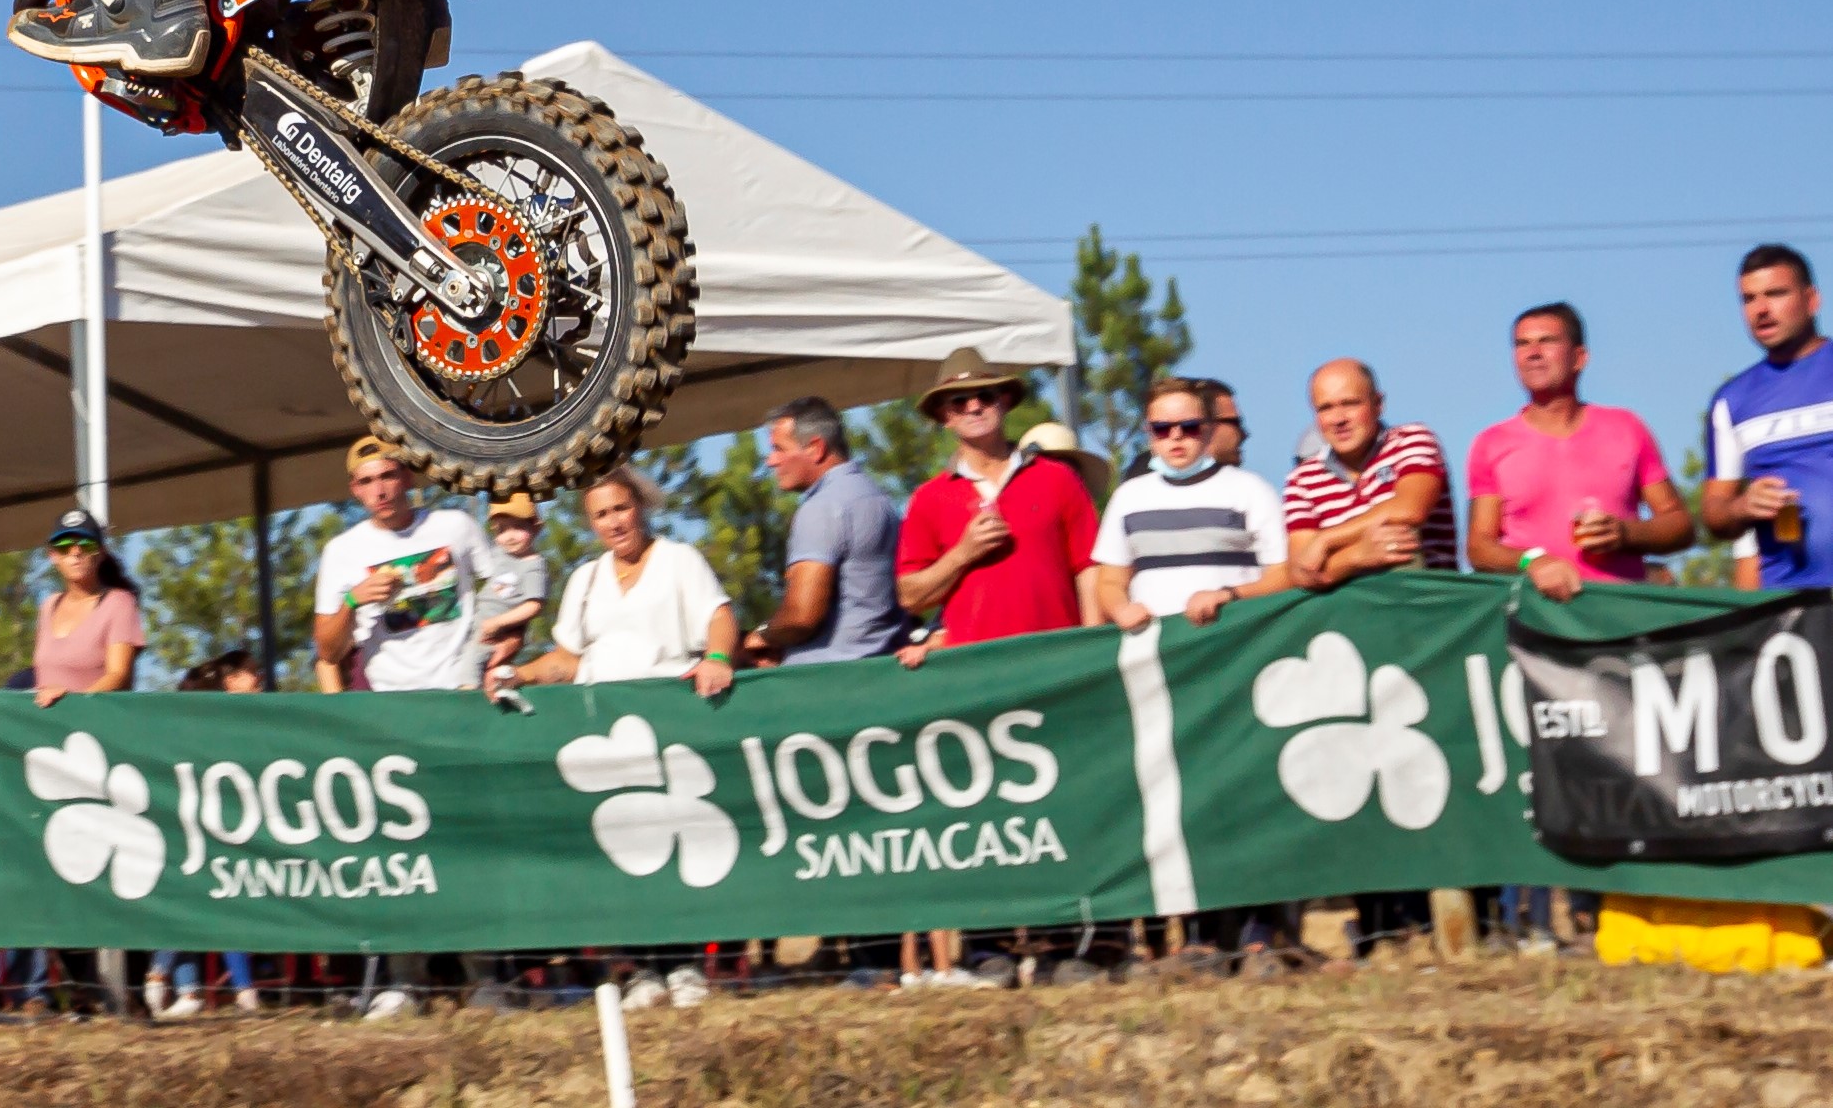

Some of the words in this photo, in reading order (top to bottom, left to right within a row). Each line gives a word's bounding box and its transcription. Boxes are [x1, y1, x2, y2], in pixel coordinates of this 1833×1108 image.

[272, 134, 311, 175] Laboratório
[310, 170, 340, 203] Dentário
[296, 132, 362, 205] Dentalig
[174, 755, 432, 875] JOGOS
[741, 709, 1059, 857] JOGOS
